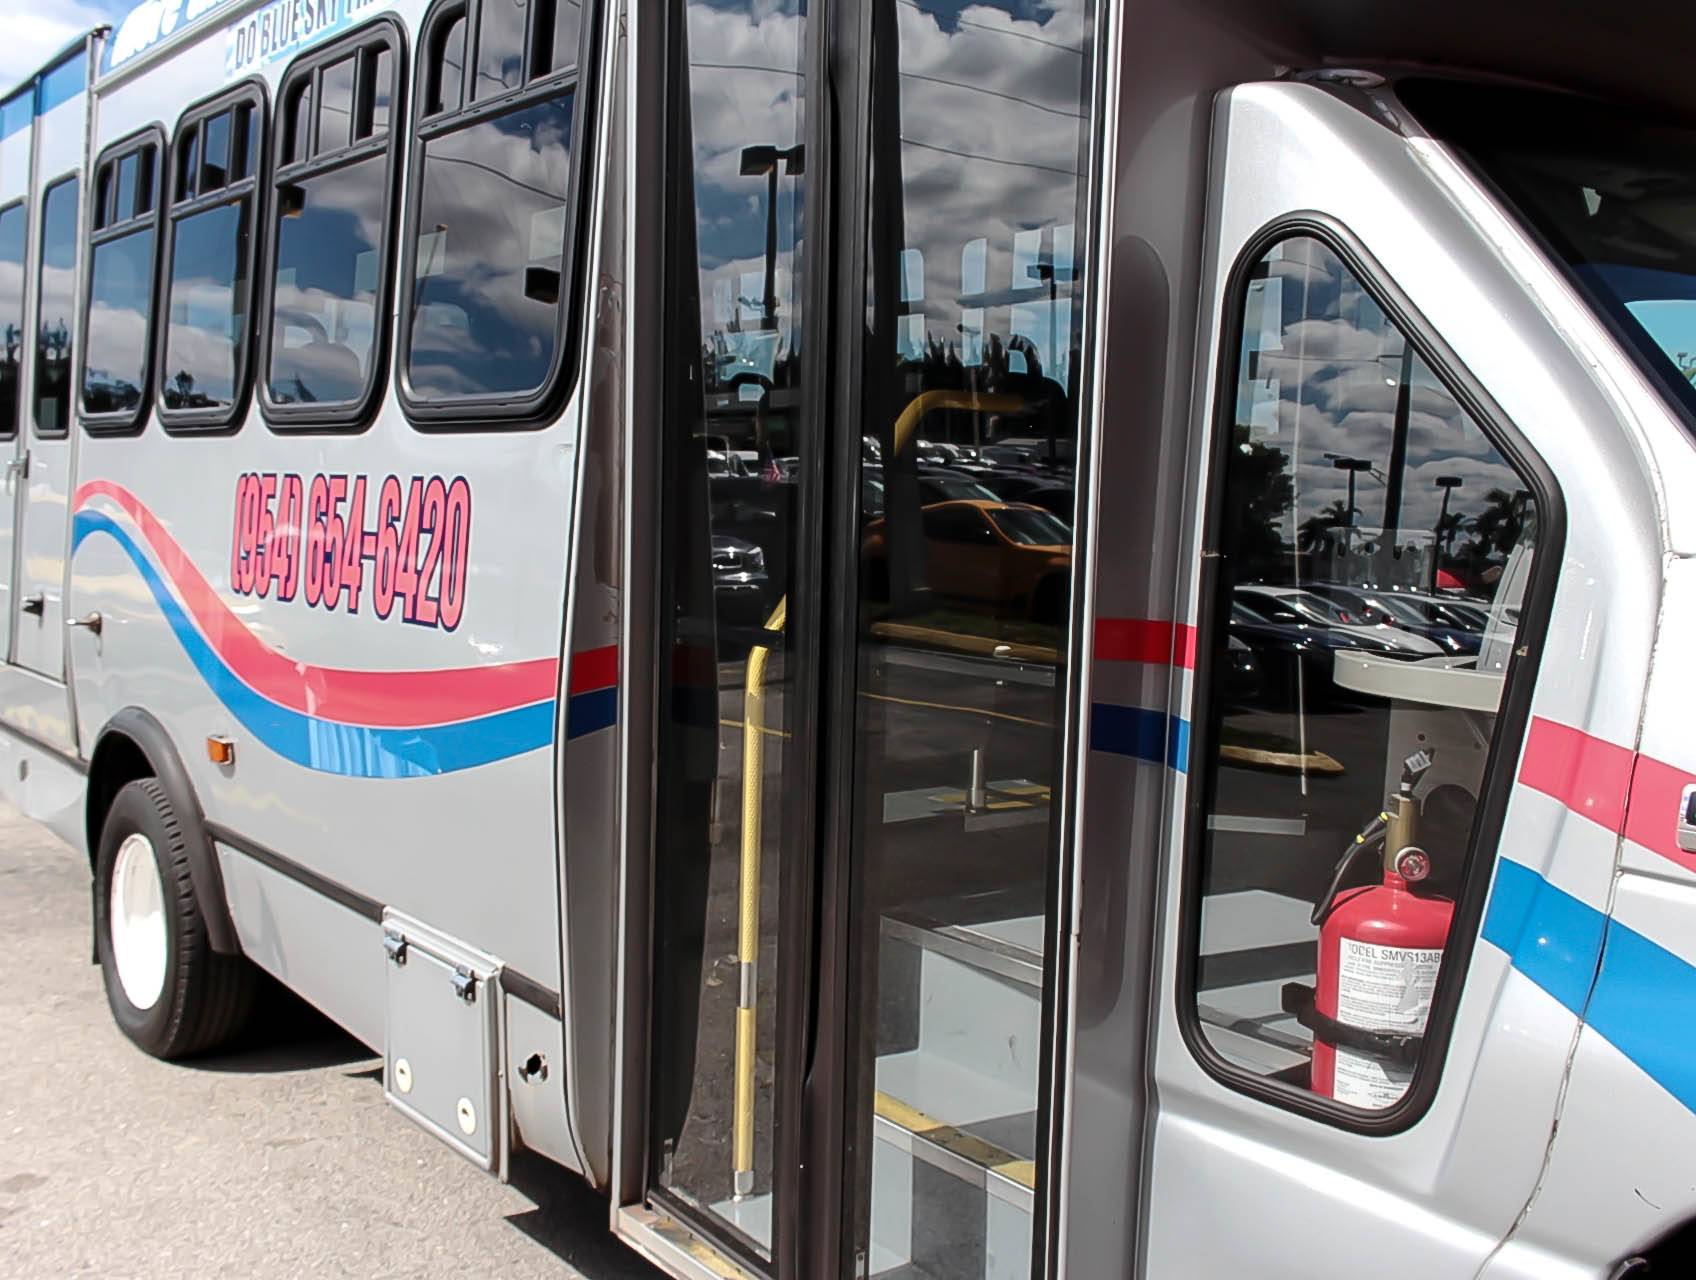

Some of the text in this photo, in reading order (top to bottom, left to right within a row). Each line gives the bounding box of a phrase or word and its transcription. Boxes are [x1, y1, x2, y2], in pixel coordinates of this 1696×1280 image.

[235, 20, 257, 69] DO
[260, 0, 299, 57] BLUE
[231, 472, 471, 632] (954) 654-6420
